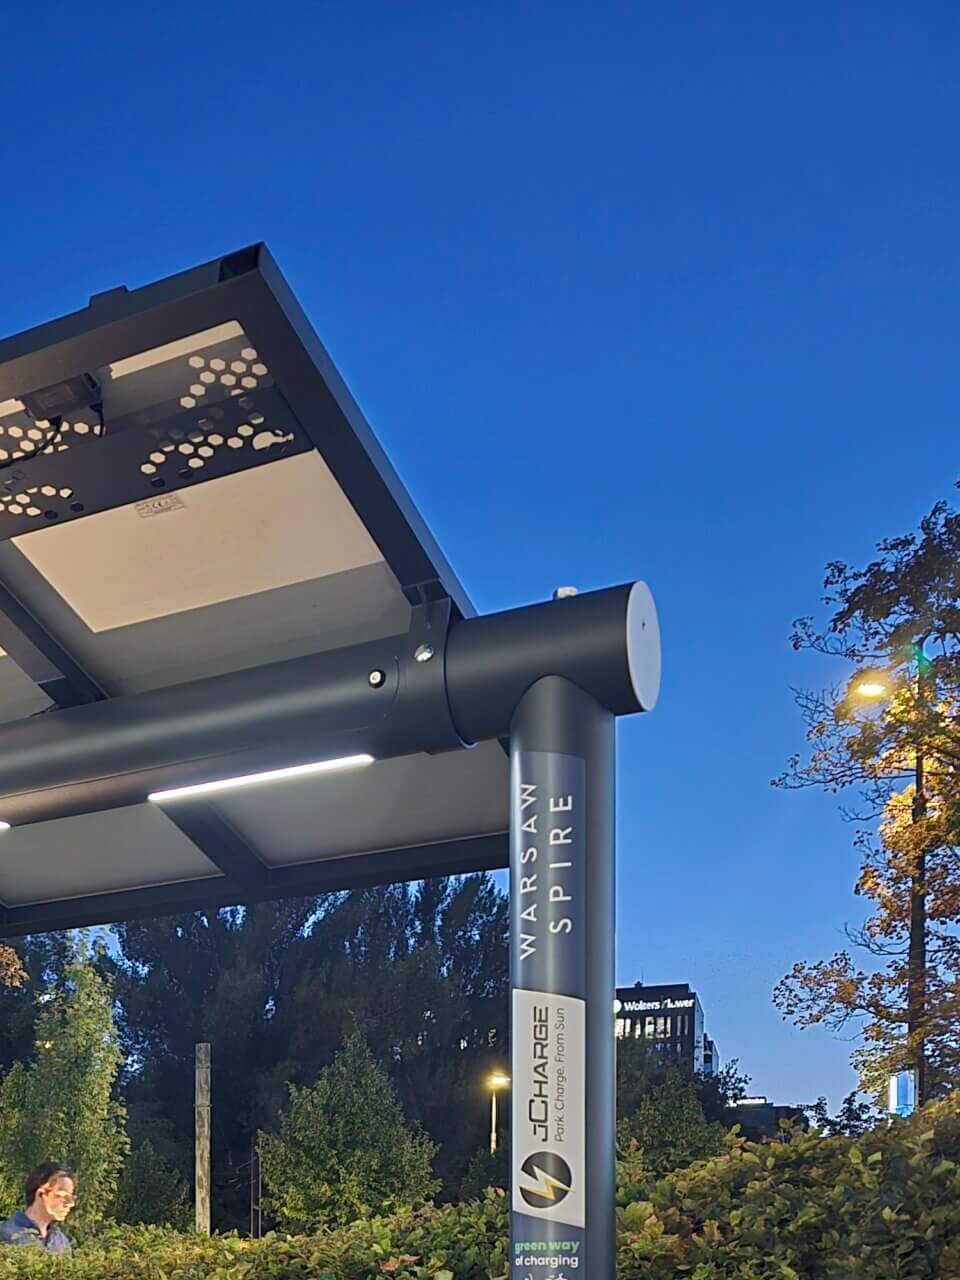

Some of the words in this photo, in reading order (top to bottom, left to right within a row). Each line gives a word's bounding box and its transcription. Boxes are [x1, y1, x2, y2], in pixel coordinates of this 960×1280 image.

[520, 783, 537, 961] WARSAW
[549, 795, 573, 933] SPIRE
[554, 1007, 565, 1031] Sun
[554, 1033, 565, 1063] From
[514, 1241, 548, 1254] green
[548, 1241, 580, 1254] way
[515, 1255, 524, 1266] of
[524, 1254, 579, 1268] charging
